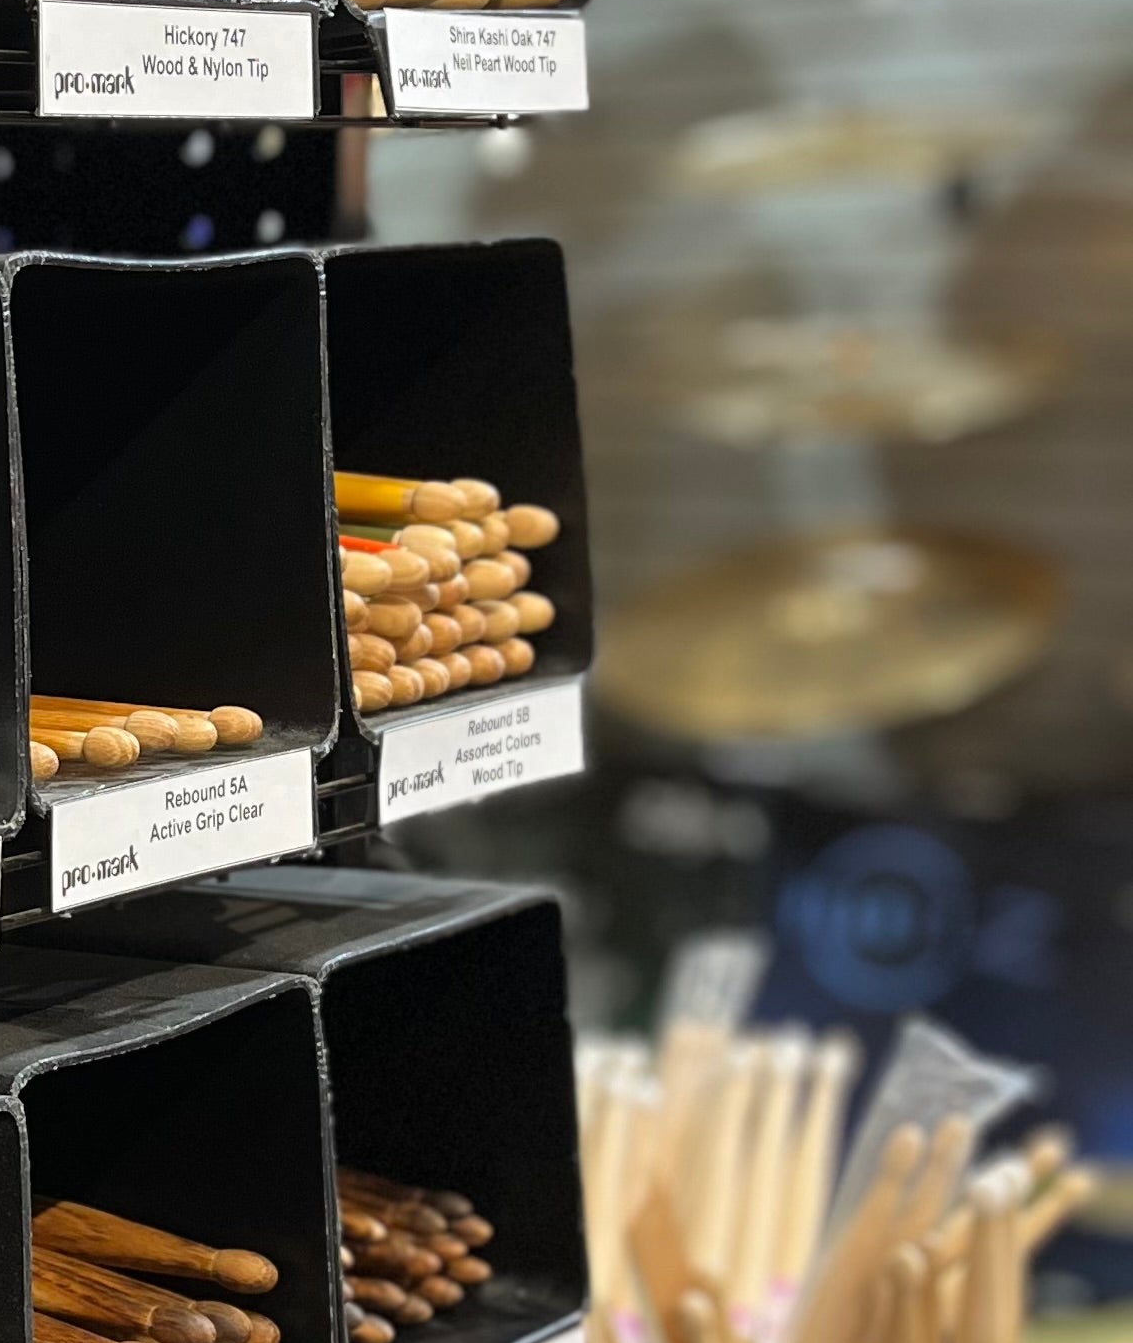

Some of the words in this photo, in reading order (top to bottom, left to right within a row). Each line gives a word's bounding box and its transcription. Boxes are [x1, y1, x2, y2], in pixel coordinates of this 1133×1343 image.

[164, 25, 218, 51] Hickory
[222, 28, 247, 48] 747
[449, 26, 476, 45] Shira
[479, 28, 508, 46] Kashi
[511, 29, 533, 47] Oak
[536, 30, 556, 48] 747
[142, 54, 183, 77] Wood
[188, 56, 198, 76] &
[203, 57, 243, 82] Nylon
[247, 58, 268, 82] Tip
[453, 53, 471, 71] Neil
[475, 54, 501, 73] Peart
[505, 55, 535, 73] Wood
[538, 56, 557, 76] Tip
[468, 711, 513, 738] Rebound
[516, 706, 530, 723] 5B
[455, 738, 502, 765] Assorted
[505, 731, 542, 752] Colors
[472, 764, 504, 786] Wood
[506, 760, 523, 778] Tip
[165, 780, 226, 811] Rebound
[230, 774, 249, 795] 5A
[149, 814, 192, 844] Active
[196, 808, 225, 831] Grip
[229, 801, 264, 823] Clear
